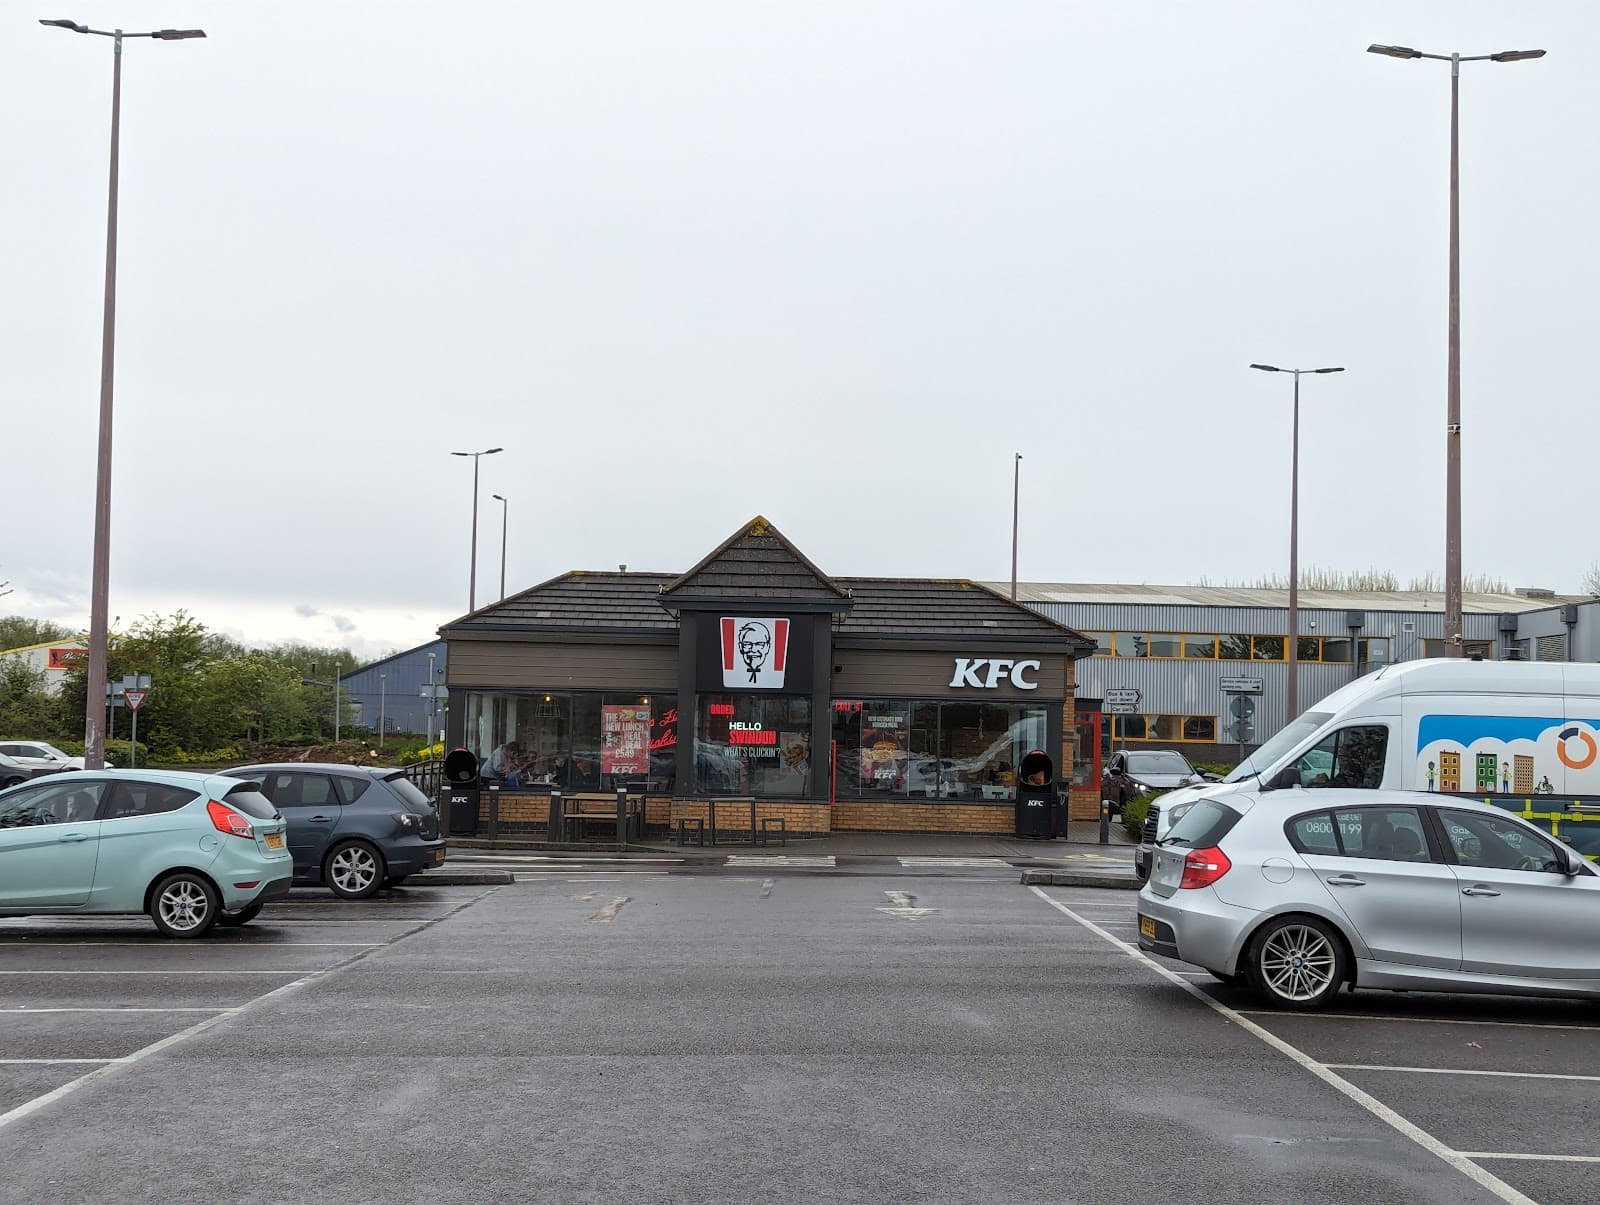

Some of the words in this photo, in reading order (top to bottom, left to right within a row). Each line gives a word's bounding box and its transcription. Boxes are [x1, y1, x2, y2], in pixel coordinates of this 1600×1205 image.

[949, 658, 1041, 690] KFC
[605, 712, 619, 722] THE
[606, 722, 621, 732] NEW
[622, 722, 644, 732] LUNCH
[729, 721, 762, 731] HELLO
[624, 731, 642, 741] MEAL
[729, 730, 777, 745] SWINDON
[625, 740, 643, 750] DEAL
[723, 747, 748, 758] WHAT'S
[610, 765, 638, 774] KFC
[1027, 799, 1045, 807] KFC
[1306, 822, 1333, 833] 0800
